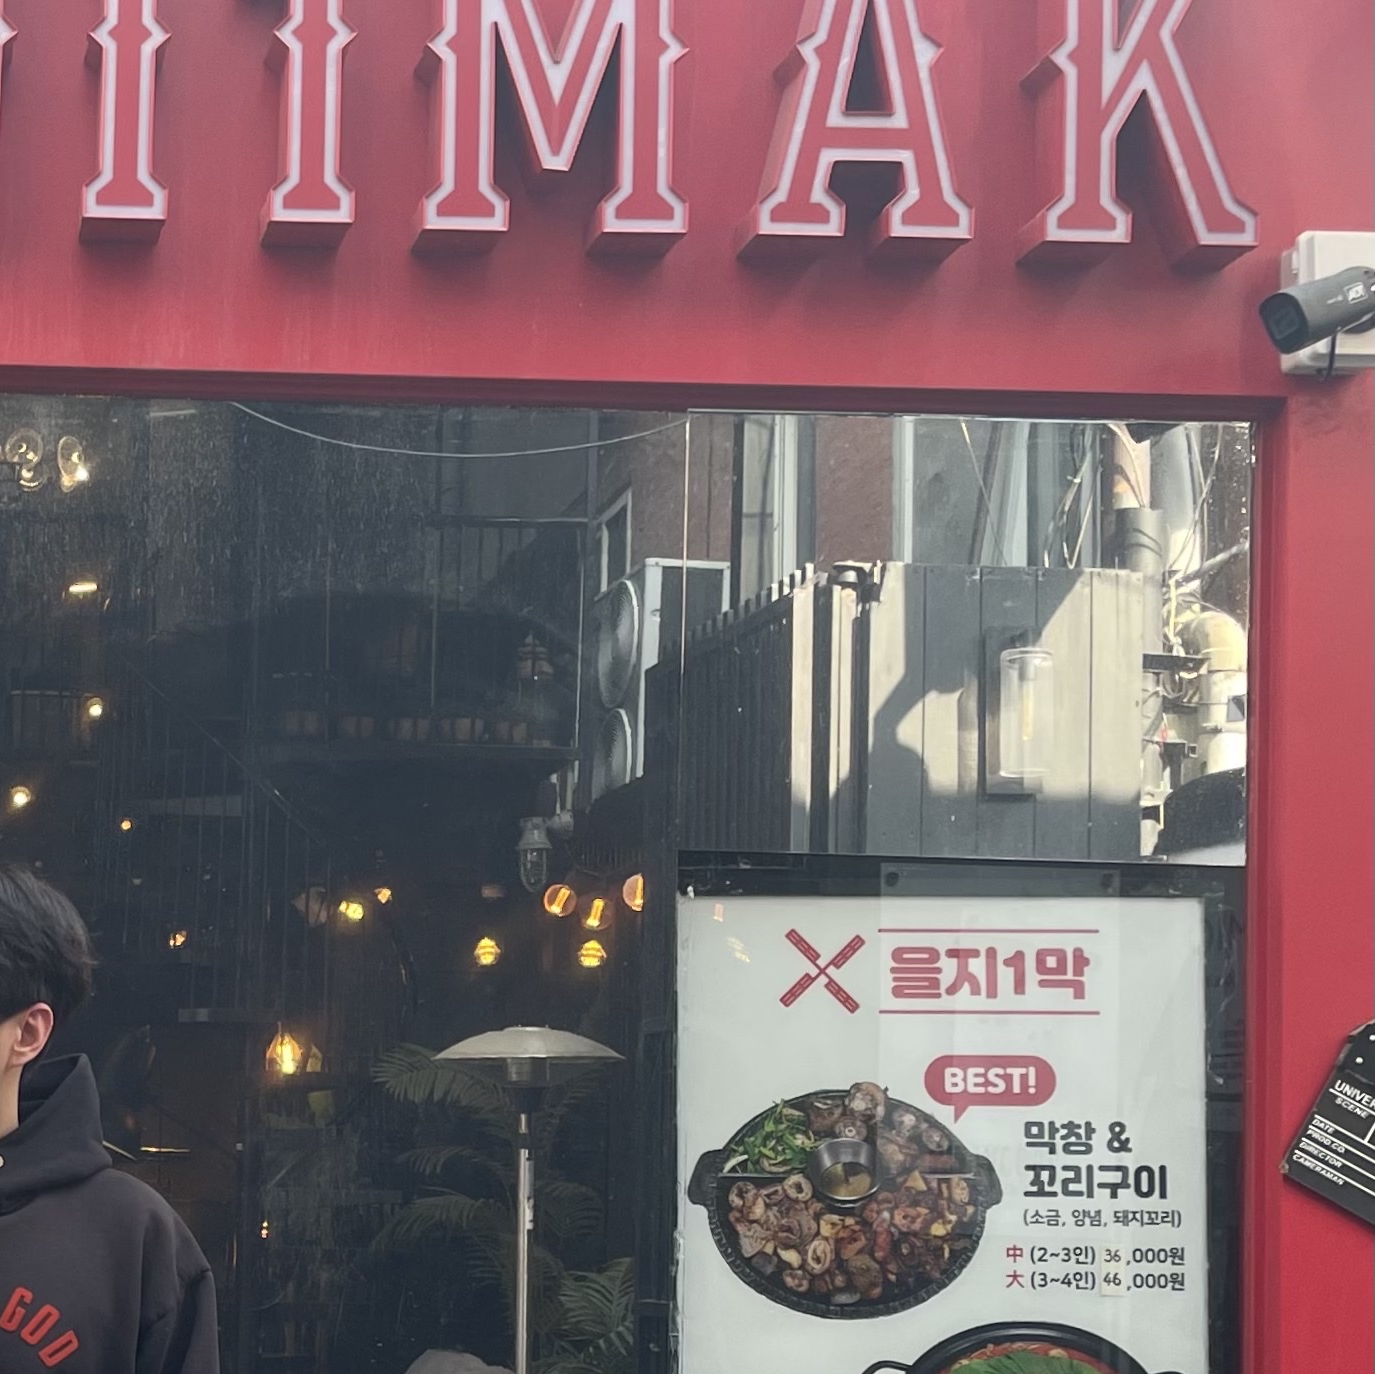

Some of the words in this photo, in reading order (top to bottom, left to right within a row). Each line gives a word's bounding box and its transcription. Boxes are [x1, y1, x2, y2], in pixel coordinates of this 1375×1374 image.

[890, 946, 1091, 1000] 을지1막
[944, 1067, 1037, 1094] BEST!
[1024, 1120, 1096, 1155] 막창
[1106, 1121, 1132, 1153] &
[1023, 1164, 1167, 1199] 꼬리구이
[1023, 1208, 1066, 1227] (소금,
[1072, 1209, 1108, 1227] 양념,
[1113, 1209, 1182, 1228] 돼지꼬리)
[1006, 1245, 1023, 1263] 中
[1030, 1246, 1096, 1265] (2~3인)
[1006, 1270, 1024, 1288] 大
[1030, 1271, 1096, 1290] (3~4인)
